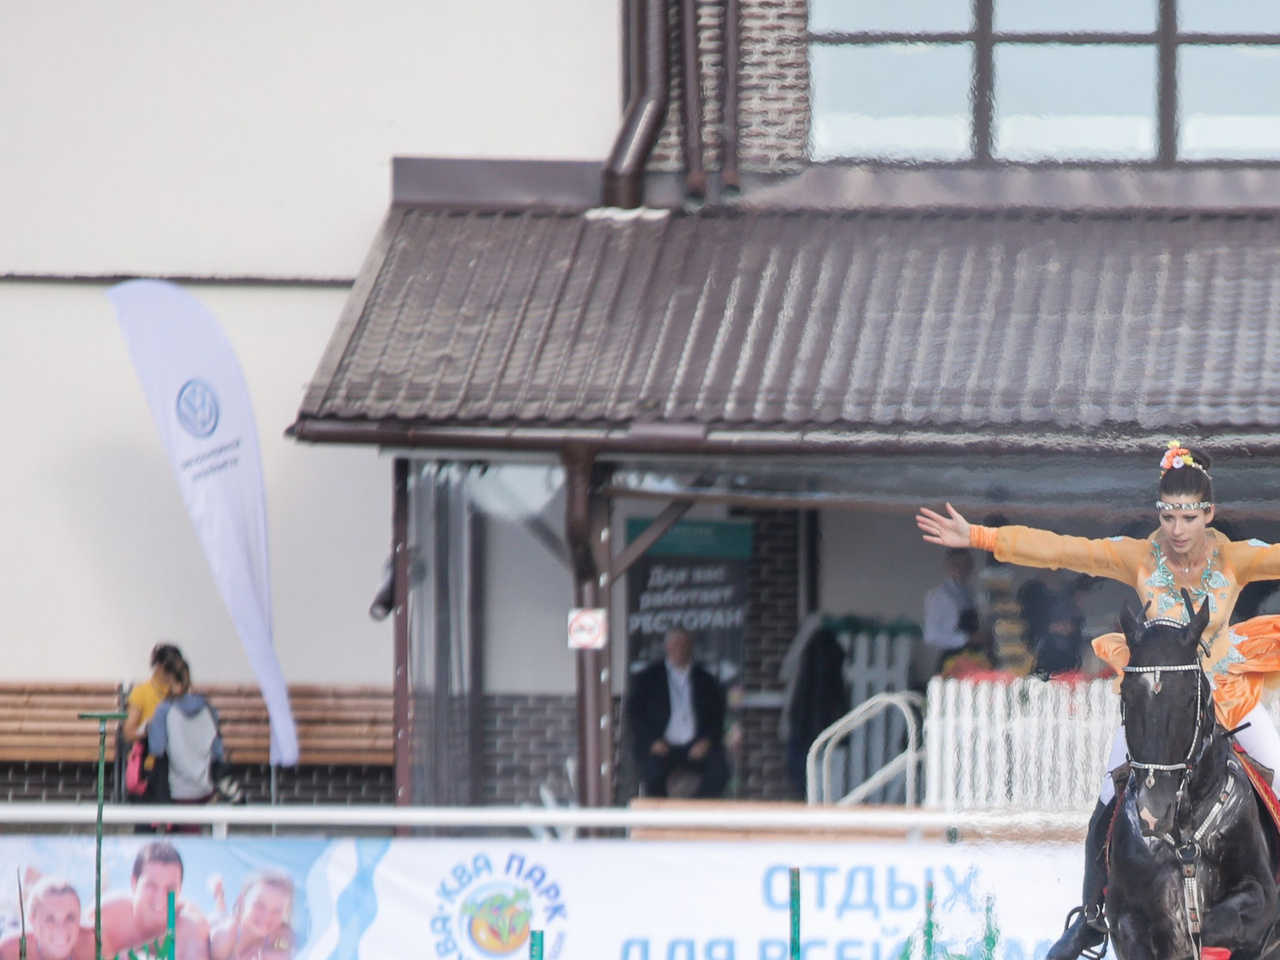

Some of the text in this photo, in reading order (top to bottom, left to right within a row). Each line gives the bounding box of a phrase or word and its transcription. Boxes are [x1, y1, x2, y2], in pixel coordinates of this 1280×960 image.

[628, 606, 746, 635] РЕСТОРАН
[504, 852, 567, 925] ПАРК
[762, 865, 981, 914] ОТДЫХ
